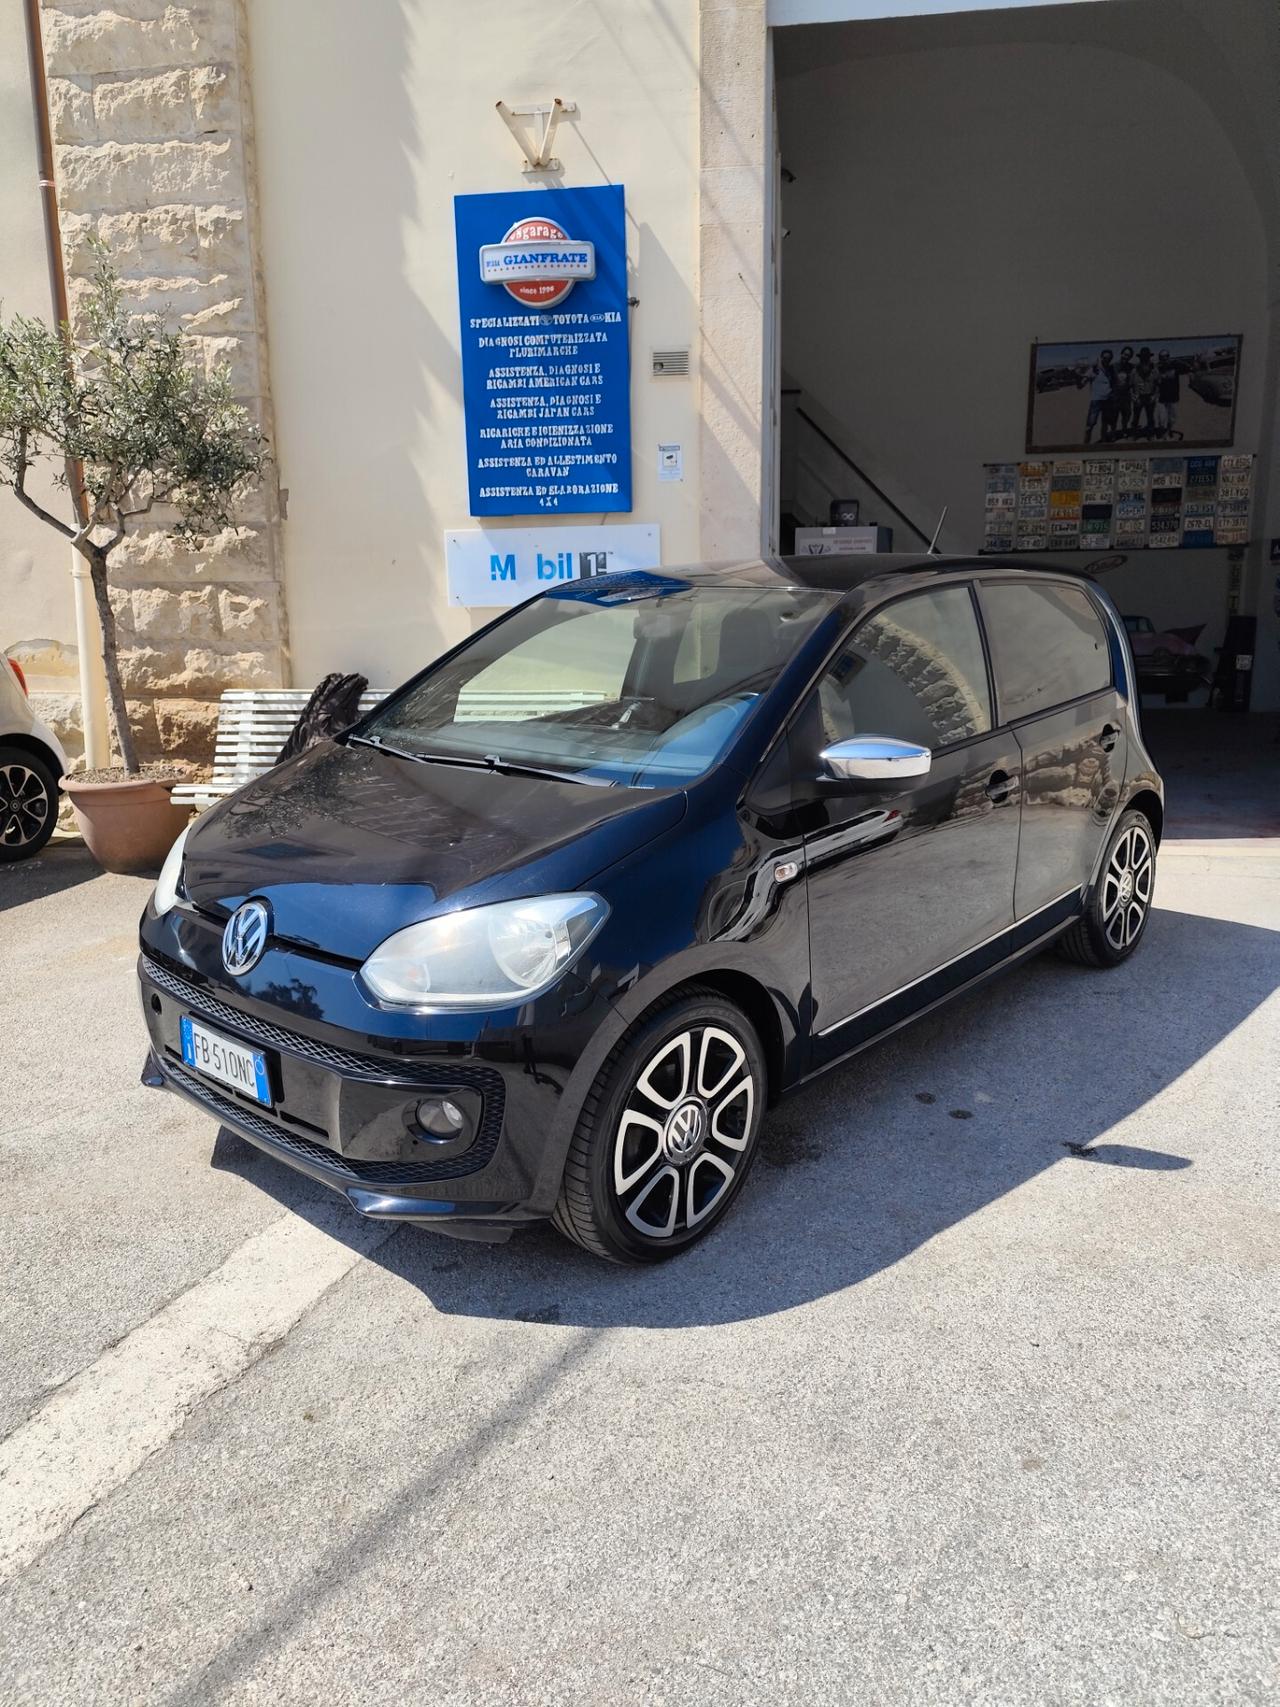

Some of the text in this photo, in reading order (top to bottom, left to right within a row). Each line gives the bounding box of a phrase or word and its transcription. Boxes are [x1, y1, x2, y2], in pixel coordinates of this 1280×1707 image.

[503, 253, 588, 265] GIANFRATE
[519, 286, 537, 295] since
[470, 315, 540, 328] SPECIALIZZATI
[553, 313, 589, 325] TOYOTA
[604, 312, 622, 323] KIA
[479, 332, 608, 348] DIAGNOSI COMPUTERIZZATA
[509, 345, 578, 358] PLURIMARCHE
[549, 364, 593, 375] DIAGNOSI
[595, 363, 601, 373] E
[486, 375, 603, 390] RICAMBI AMERICAN CARS
[550, 395, 593, 406] DIAGNOSI
[595, 394, 602, 404] E
[497, 406, 595, 419] RICAMBI JAPAN CARS
[480, 426, 531, 438] RICARICHE
[539, 424, 614, 436] IGIENIZZAZIONE
[501, 436, 592, 449] ARIA CONDIZIONATA
[478, 453, 618, 468] ASSISTENZA ED ALLESTIMENTO
[526, 466, 570, 478] CARAVAN
[479, 483, 619, 498] ASSISTENZA ED ELABORAZIONE
[490, 553, 572, 581] Mbil
